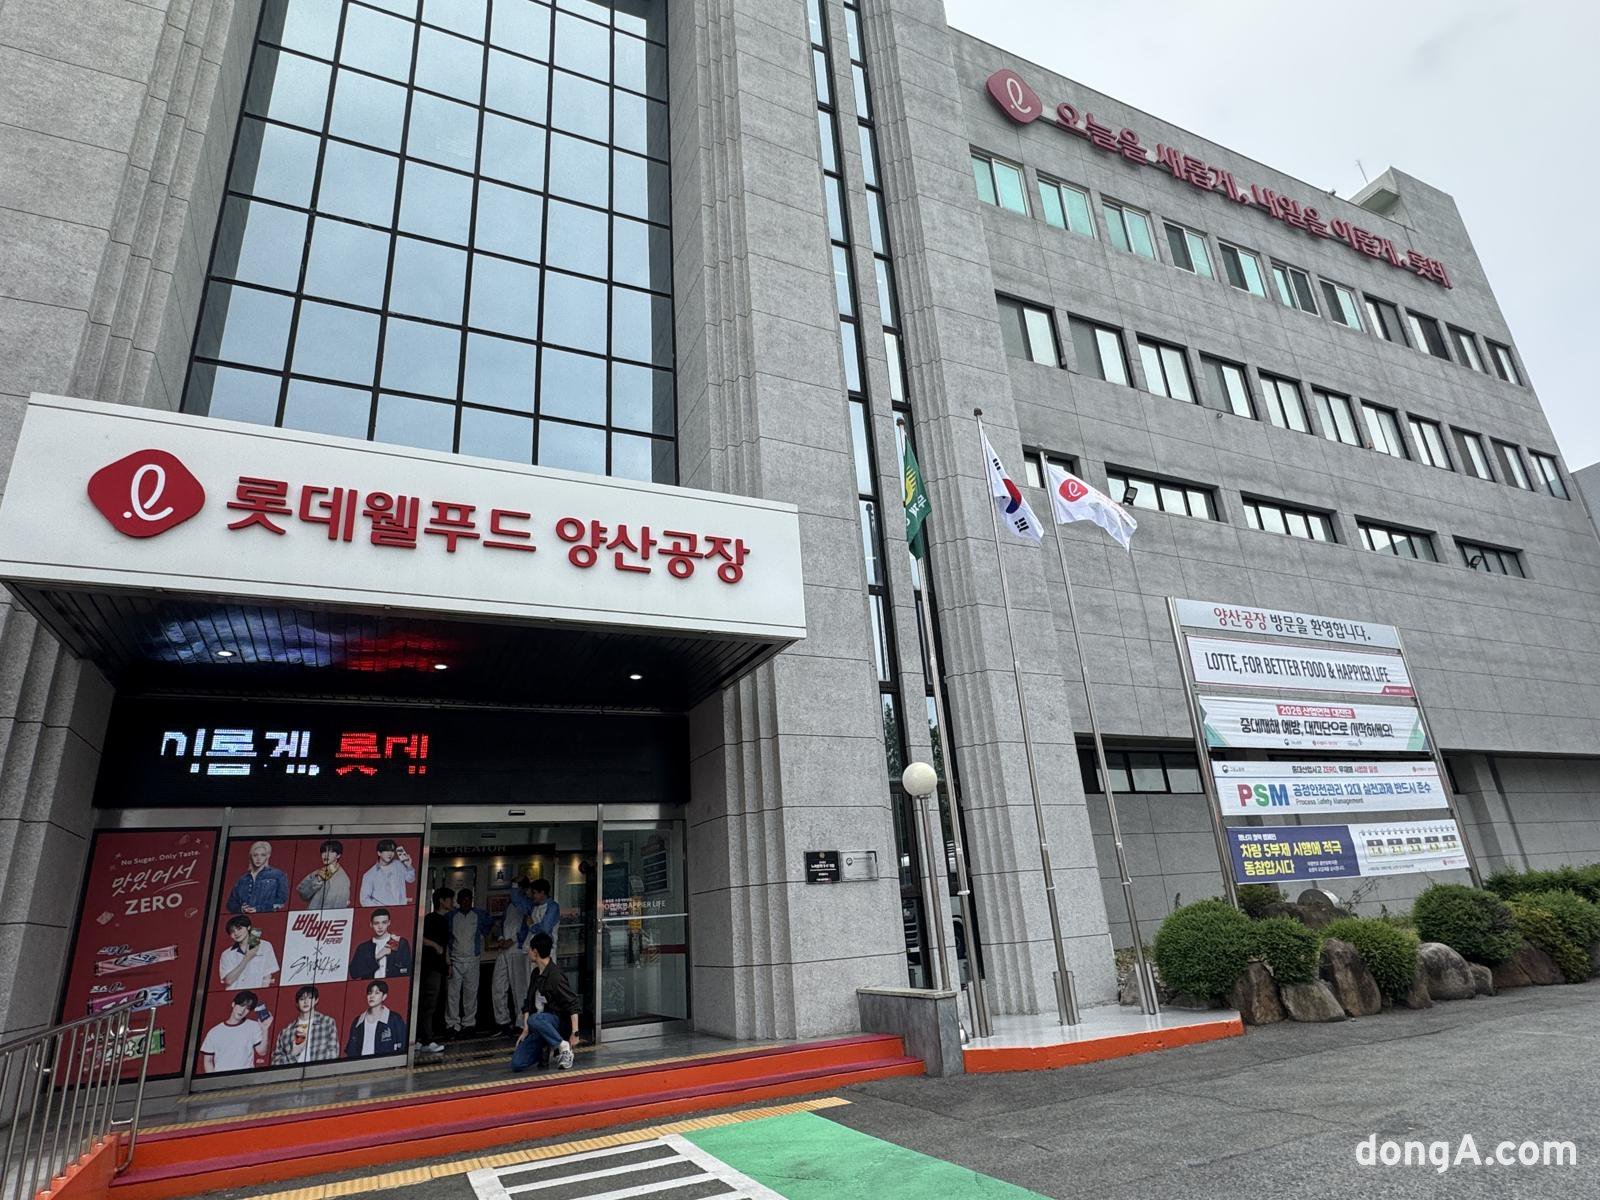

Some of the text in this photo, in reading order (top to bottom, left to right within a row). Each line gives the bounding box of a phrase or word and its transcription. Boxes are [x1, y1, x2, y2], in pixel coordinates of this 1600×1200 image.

[1056, 102, 1453, 289] 오늘을 새롭게, 내일을 이롭게, 롯데
[226, 475, 750, 584] 롯데웰푸드 양산공장
[1214, 607, 1371, 642] 양산공장 방문을 환영합니다.
[1205, 652, 1391, 683] LOTTE, FOR BETTER FOOD & HAPPIER LIFE
[1304, 720, 1349, 736] 대진단으로
[1237, 783, 1290, 807] PSM
[1292, 783, 1343, 797] 공정안전관리
[1344, 783, 1362, 796] 12대
[1362, 782, 1394, 795] 실천과제
[1395, 782, 1417, 794] 반드시
[159, 853, 177, 861] Only
[1240, 840, 1343, 858] 차량 5부제 시행에 적극
[112, 859, 197, 897] 맛있어서
[1244, 859, 1295, 876] 동참합시다
[125, 893, 182, 915] ZERO
[292, 913, 348, 941] 빼빼로
